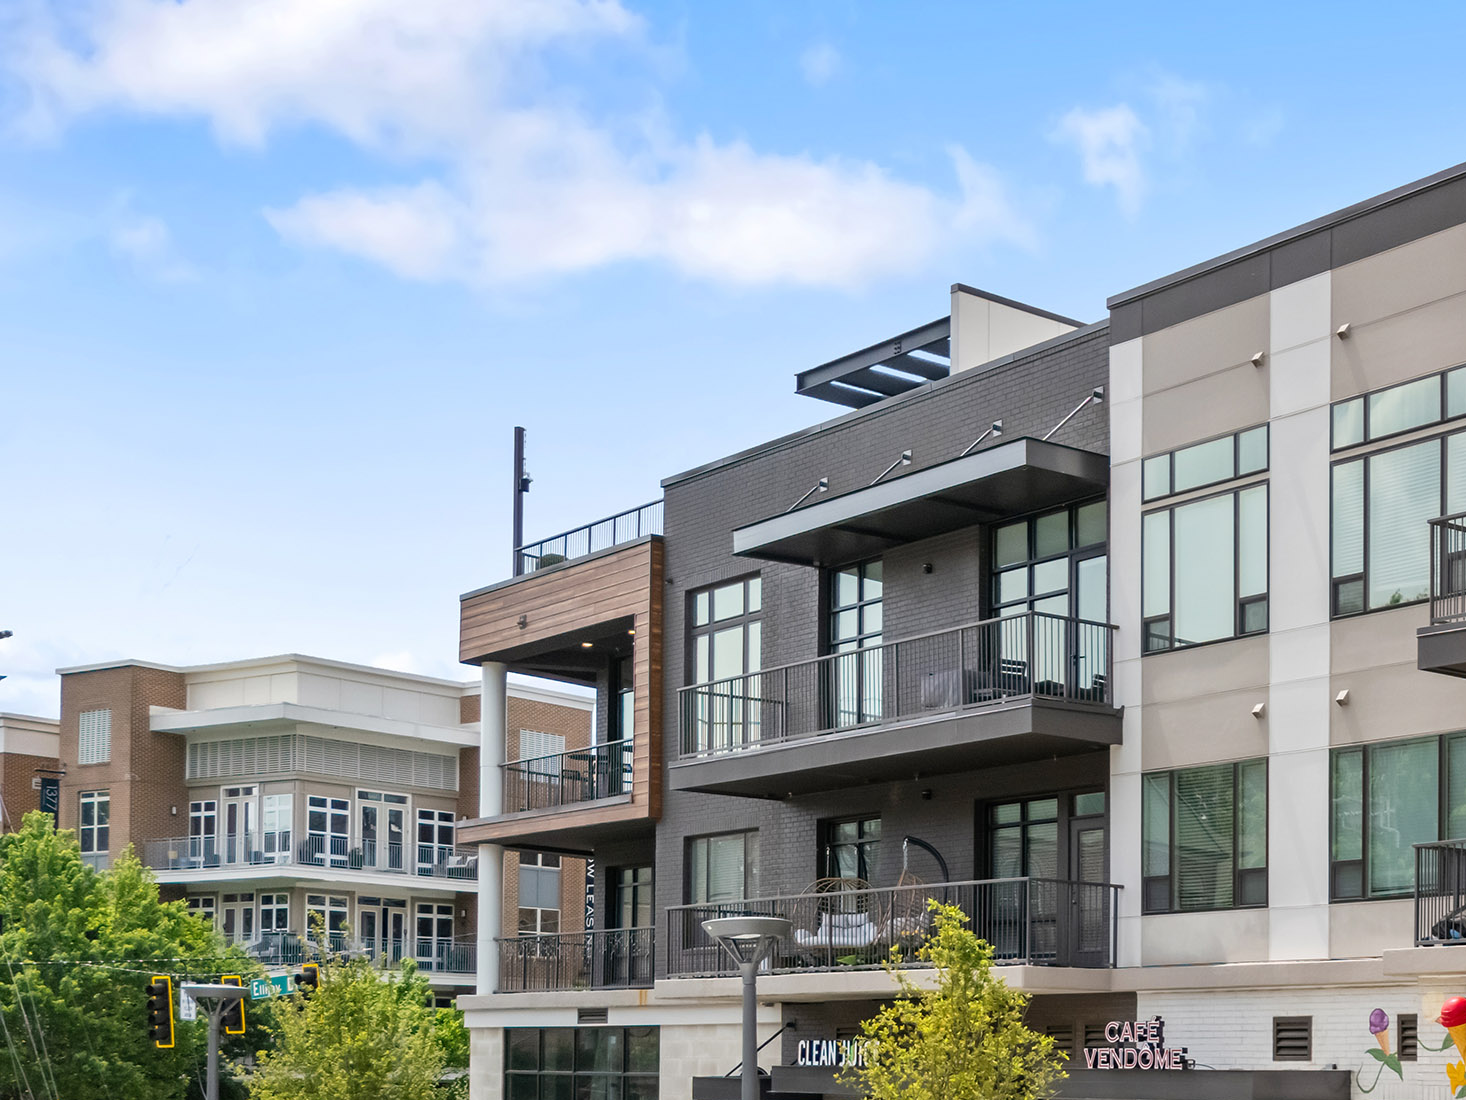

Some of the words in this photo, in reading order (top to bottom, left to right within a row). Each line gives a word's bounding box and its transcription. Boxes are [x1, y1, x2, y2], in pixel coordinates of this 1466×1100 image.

[46, 785, 58, 811] 1377
[1105, 1015, 1160, 1043] CAFÉ
[798, 1040, 837, 1066] CLEAN
[1084, 1043, 1183, 1070] VENDÔME
